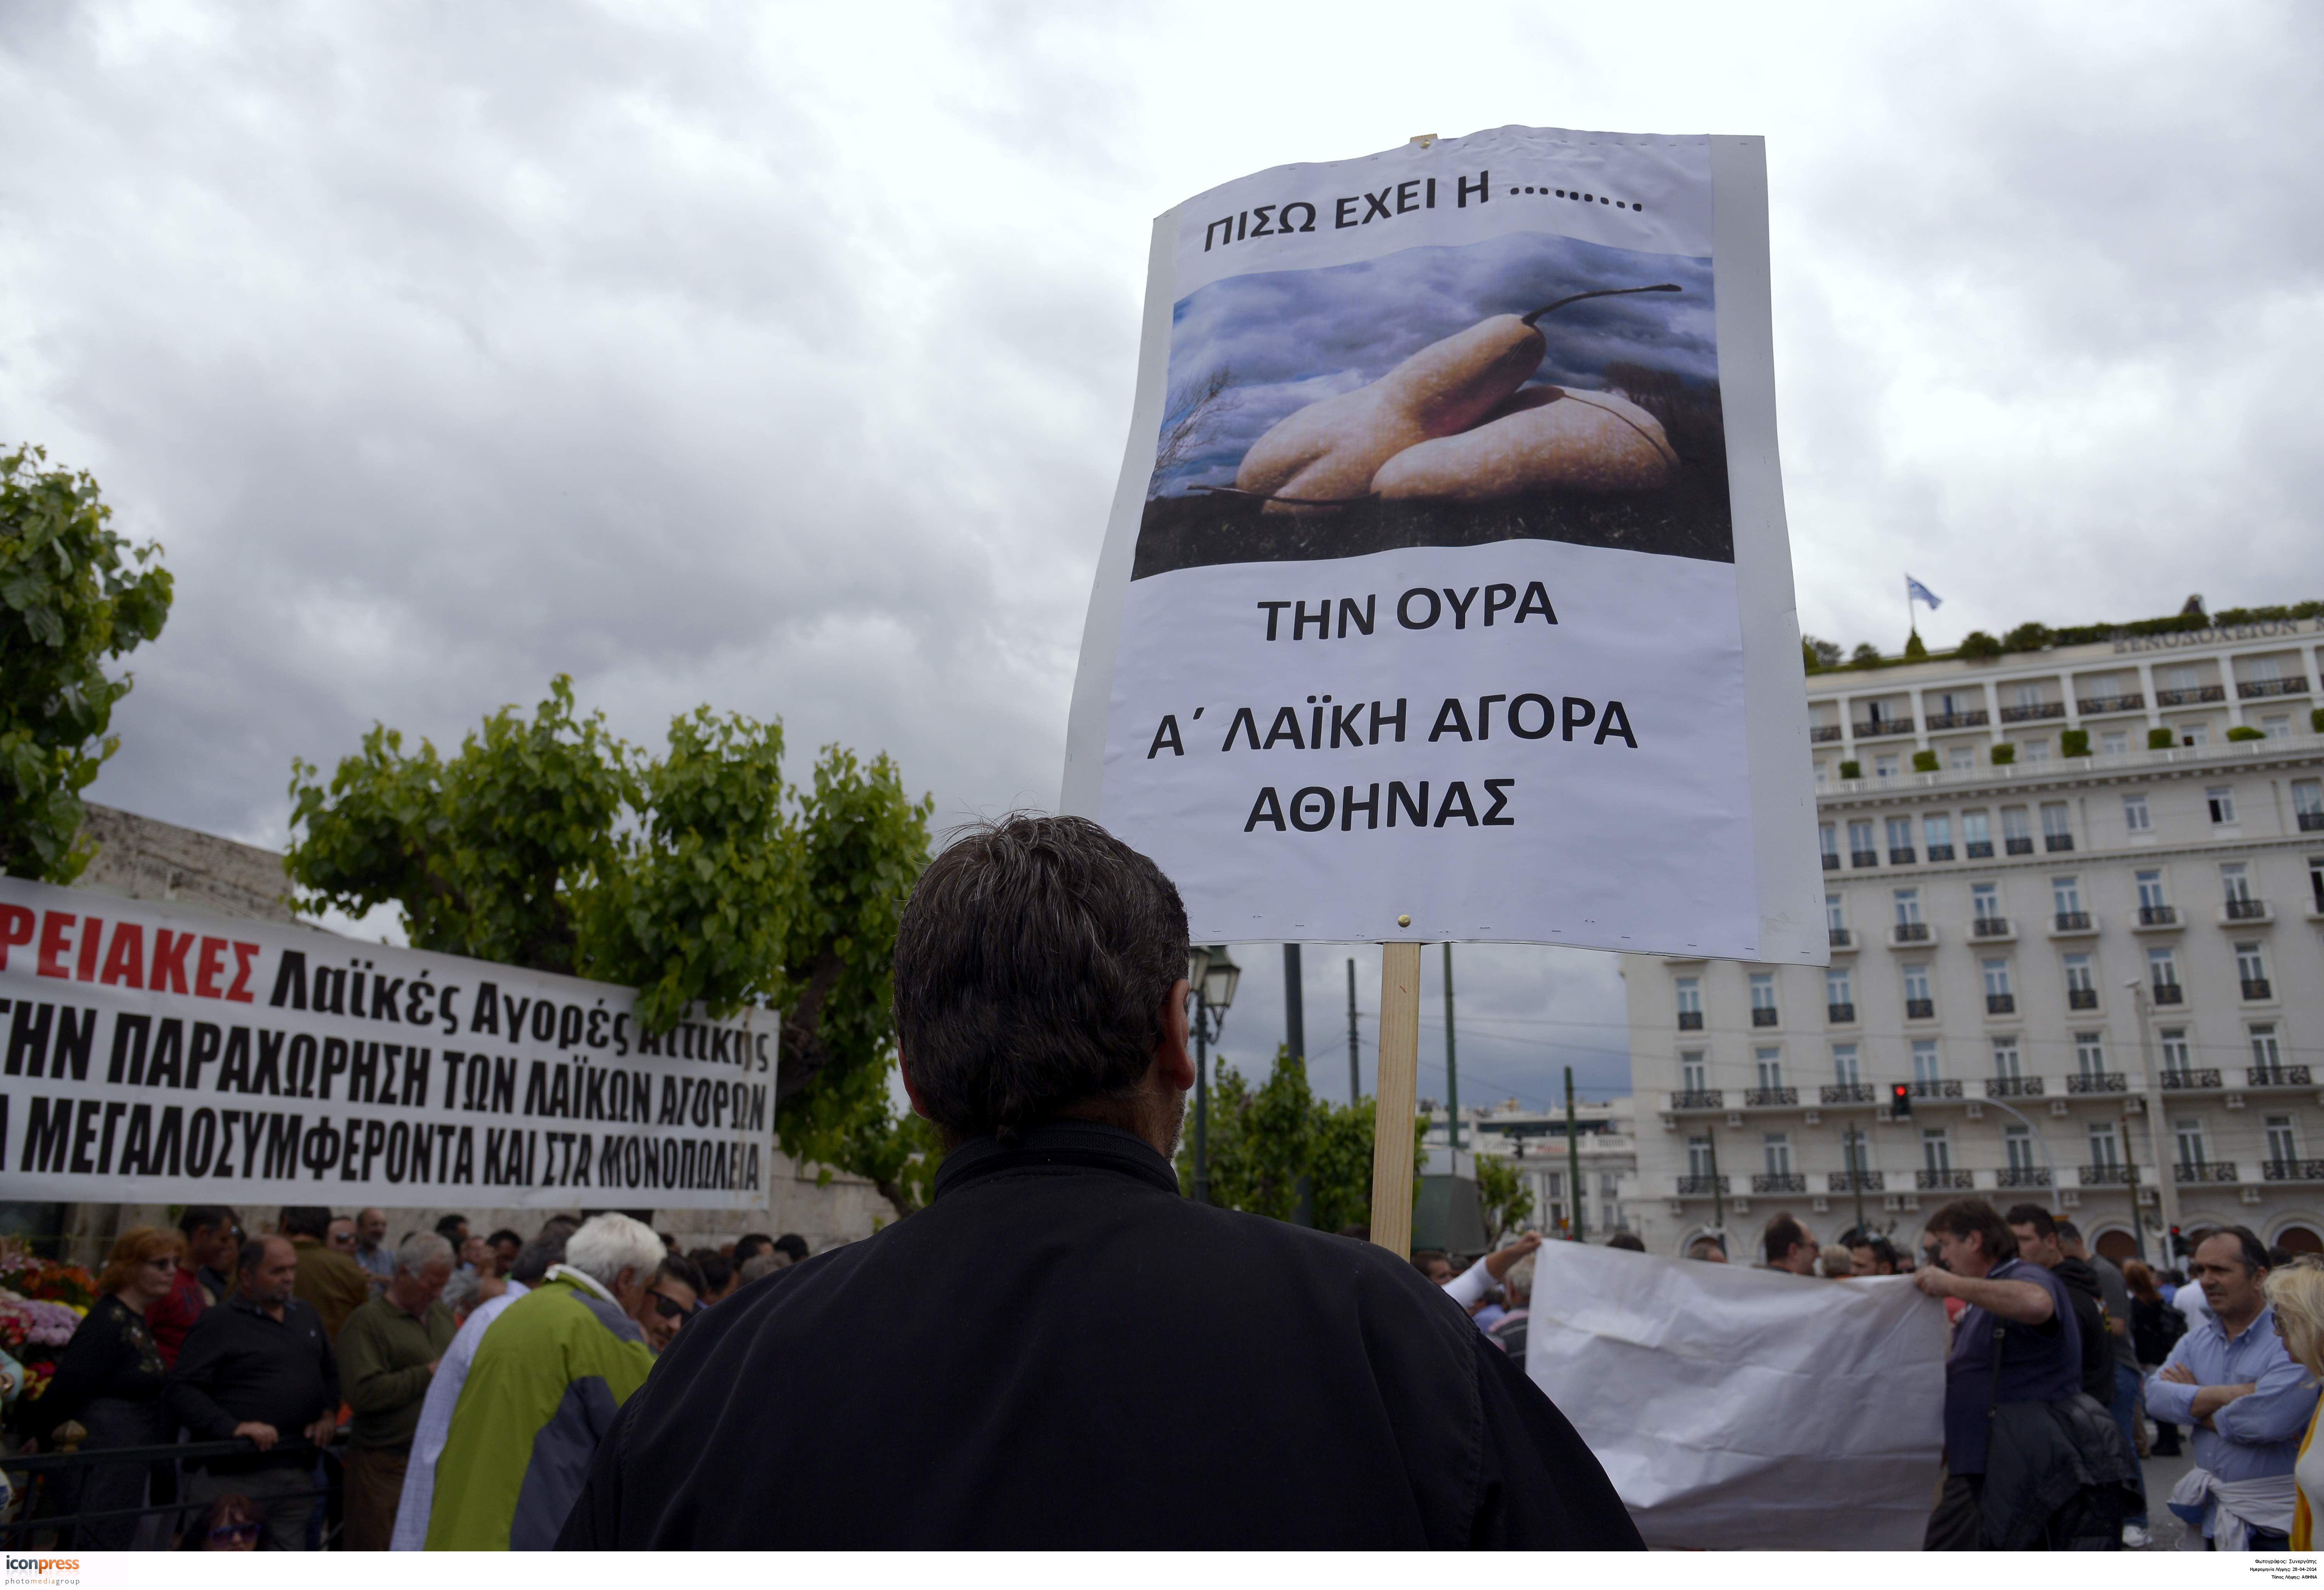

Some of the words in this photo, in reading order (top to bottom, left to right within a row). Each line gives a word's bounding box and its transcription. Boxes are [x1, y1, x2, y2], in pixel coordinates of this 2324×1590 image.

[1205, 202, 1315, 251] ΠΙΣΩ
[1335, 178, 1435, 229] ΕΧΕΙ
[1458, 171, 1488, 207] Η
[1257, 595, 1375, 641] ΤΗΝ
[1397, 581, 1558, 629] ΟΥΡΑ
[1222, 695, 1407, 751] ΛΑΪΚΗ
[1428, 693, 1638, 748] ΑΓΟΡΑ
[1244, 779, 1515, 832] ΑΘΗΝΑΣ
[0, 903, 260, 1003] ΡΕΙΑΚΕΣ
[269, 949, 461, 1035] Λαϊκές
[470, 981, 631, 1057] Αγορές
[107, 1012, 431, 1108] ΠΑΡΑΧΩΡΗΣΗ
[443, 1050, 518, 1114] ΤΩΝ
[523, 1055, 652, 1124] ΛΑΪΚΩΝ
[658, 1074, 766, 1131] ΑΓΟΡΩΝ
[20, 1096, 474, 1186] ΜΕΓΑΛΟΣΥΜΦΕΡΟΝΤΑ
[482, 1127, 537, 1186] ΚΑΙ
[542, 1130, 592, 1187] ΣΤΑ
[599, 1135, 759, 1191] ΜΟΝΟΠΩΛΕΙΑ
